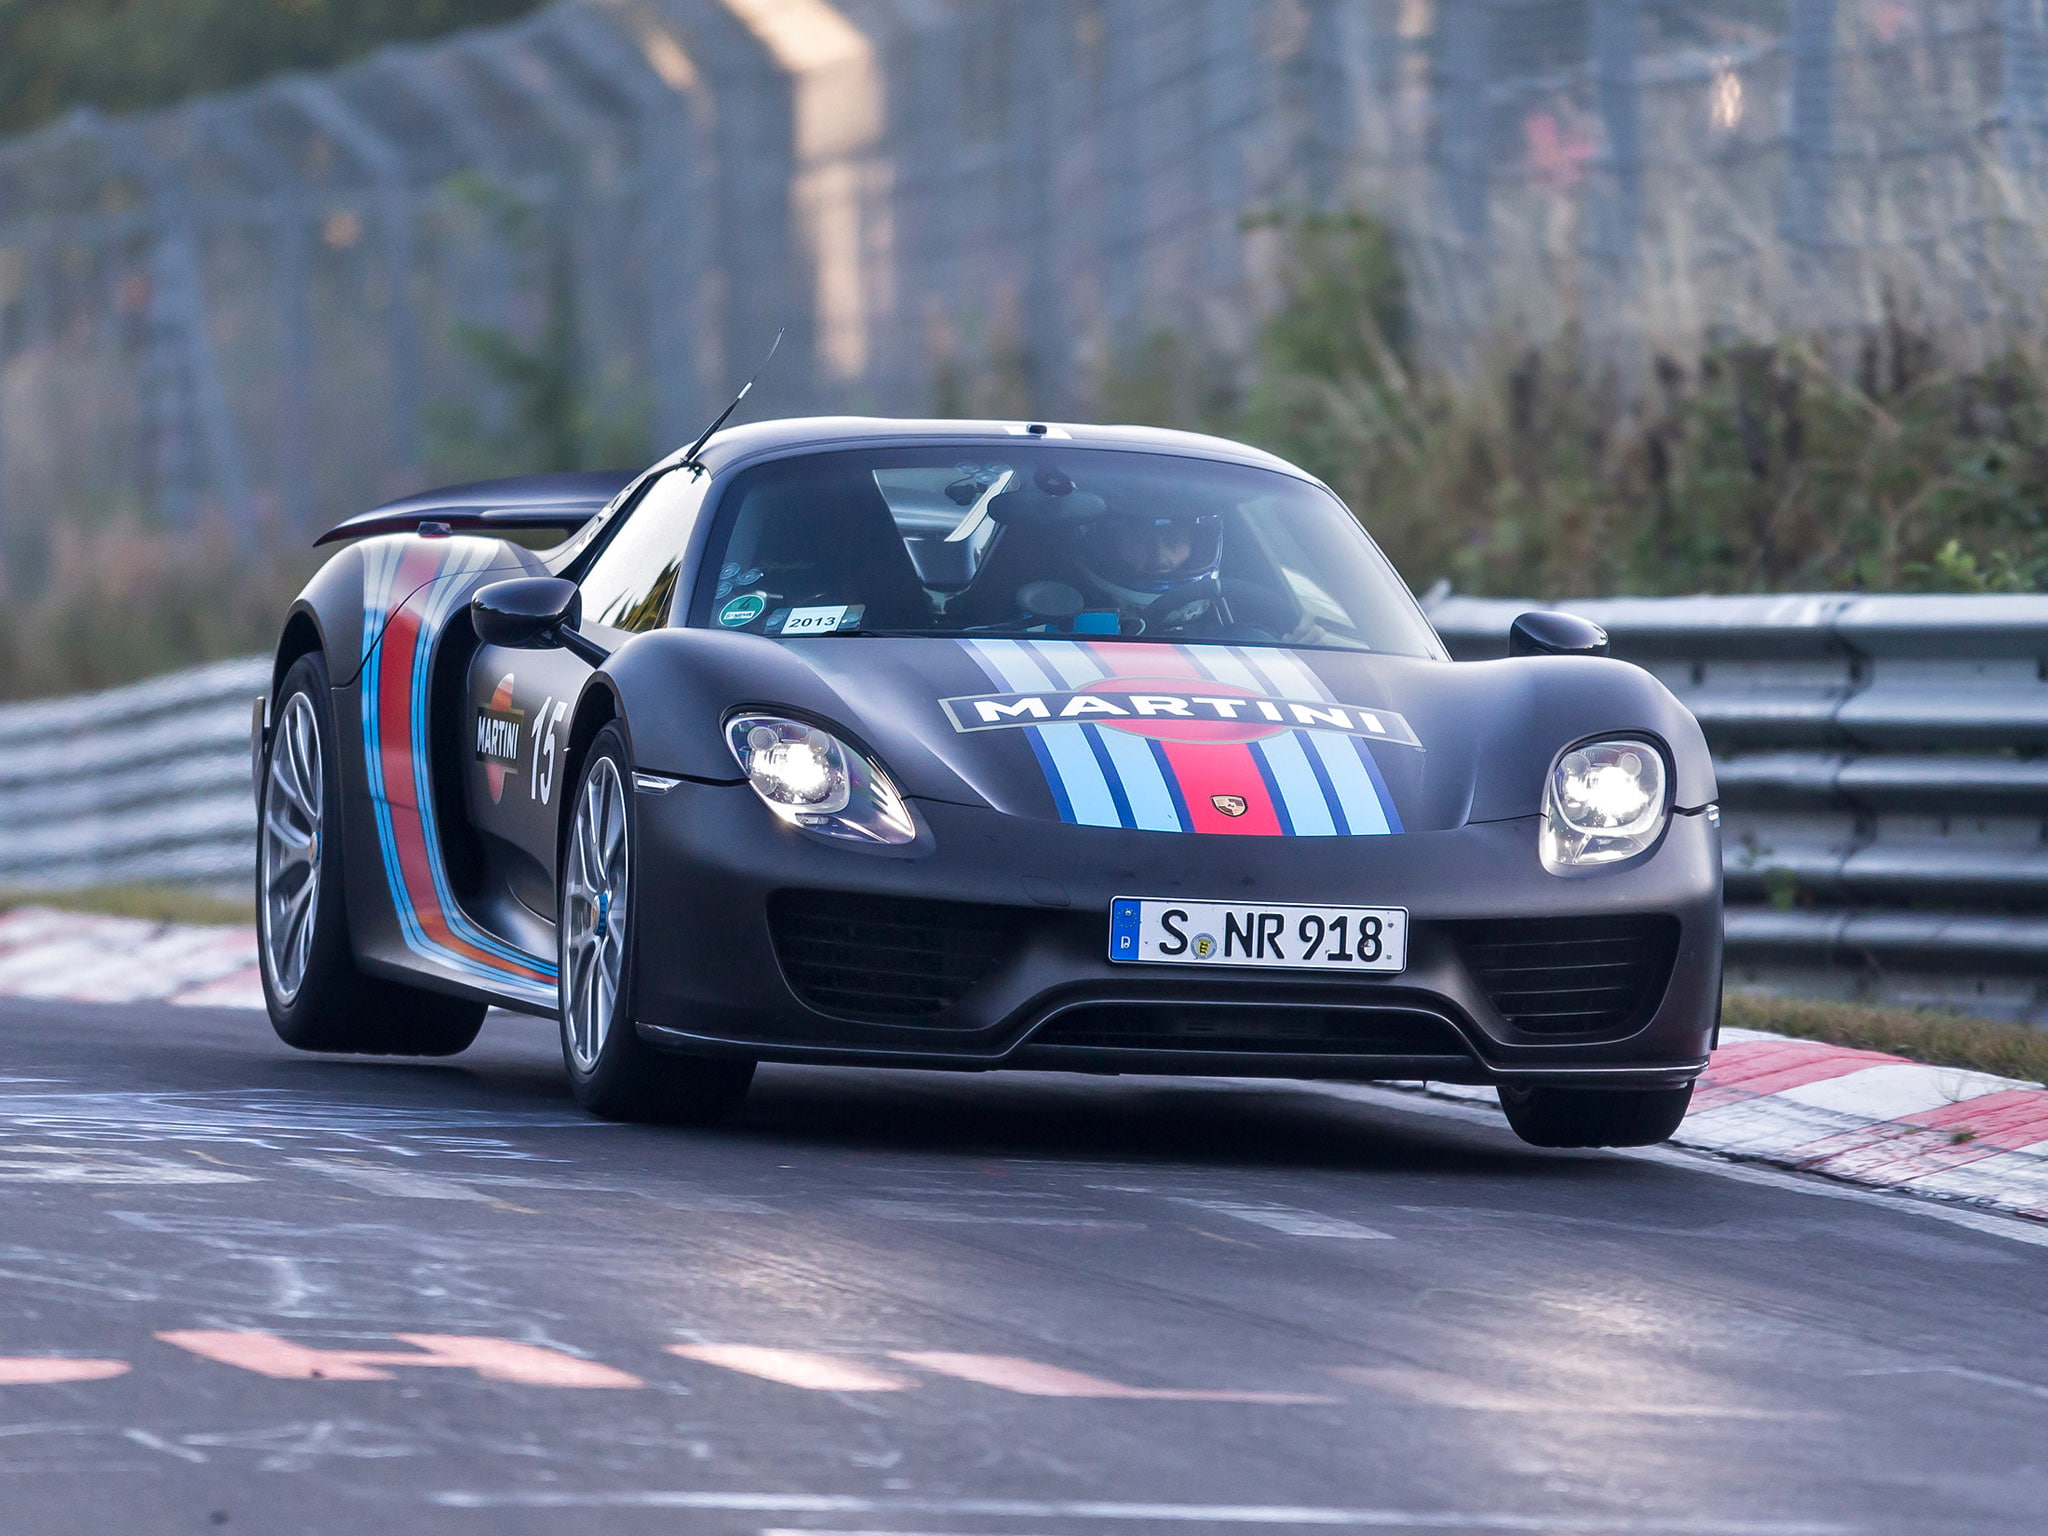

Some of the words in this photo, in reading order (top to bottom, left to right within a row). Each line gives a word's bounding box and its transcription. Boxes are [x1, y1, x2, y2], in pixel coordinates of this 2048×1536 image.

[788, 616, 836, 628] 2013
[973, 695, 1387, 734] MARTINI
[476, 715, 520, 760] MARTINI
[530, 696, 568, 805] 15
[1158, 909, 1189, 956] S
[1224, 911, 1285, 960] NR
[1298, 914, 1384, 963] 918
